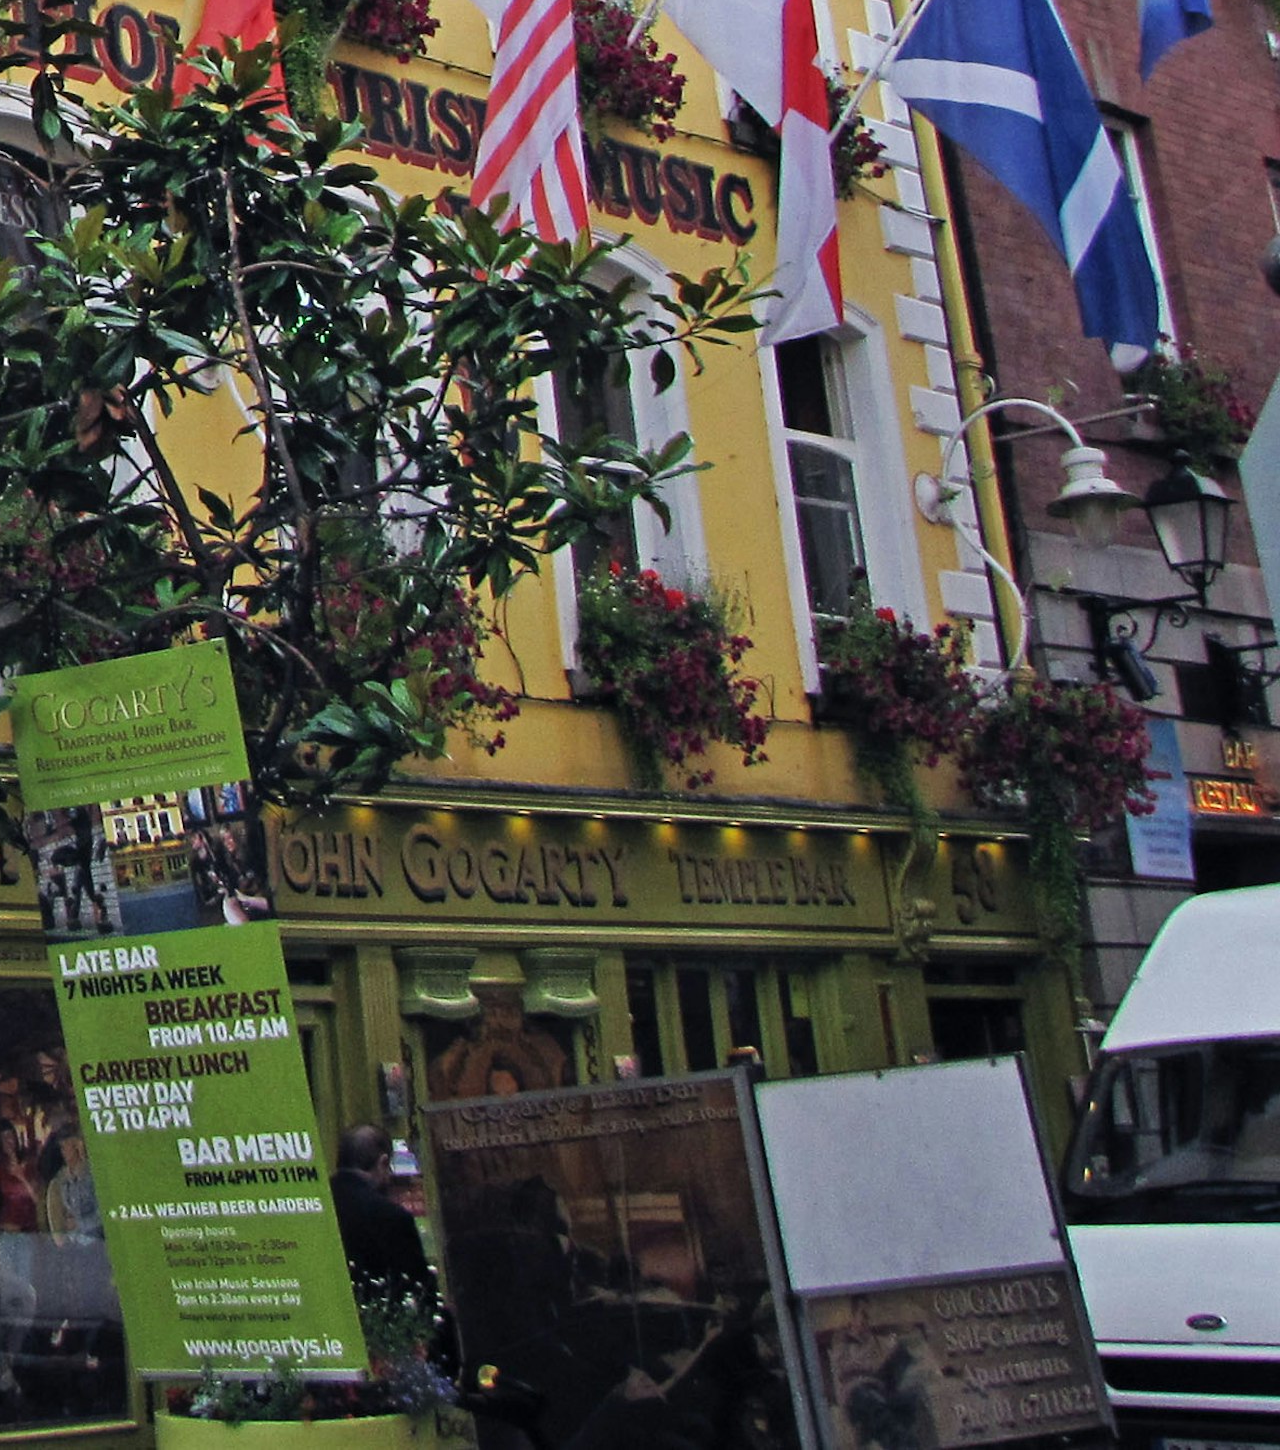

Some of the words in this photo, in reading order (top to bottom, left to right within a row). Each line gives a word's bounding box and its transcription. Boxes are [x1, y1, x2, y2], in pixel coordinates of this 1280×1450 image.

[327, 60, 487, 176] IRIS
[105, 746, 116, 762] &
[266, 818, 383, 900] JOHN
[400, 821, 630, 908] GOGARTY
[667, 847, 787, 907] TEMPLE
[788, 852, 856, 908] BAR
[59, 949, 114, 976] LATE
[114, 945, 159, 971] BAR
[63, 980, 75, 1000] 7
[81, 974, 147, 998] NIGHTS
[151, 972, 165, 991] A
[167, 965, 226, 988] WEEK
[144, 989, 281, 1025] BREAKFAST
[148, 1027, 203, 1048] FROM
[205, 1019, 257, 1044] 10.45
[259, 1016, 290, 1039] AM
[80, 1055, 174, 1084] CARVERY
[176, 1050, 251, 1077] LUNCH
[84, 1083, 150, 1111] EVERY
[153, 1080, 194, 1104] DAY
[90, 1111, 117, 1134] 12
[118, 1108, 144, 1131] TO
[146, 1104, 192, 1129] 4PM
[177, 1136, 234, 1166] BAR
[234, 1131, 314, 1163] MENU
[184, 1171, 226, 1188] FROM
[227, 1168, 258, 1185] 4PM
[259, 1167, 279, 1183] TO
[280, 1165, 319, 1183] 11PM
[130, 1204, 153, 1219] ALL
[155, 1200, 219, 1218] WEATHER
[221, 1199, 257, 1215] BEER
[259, 1196, 323, 1214] GARDENS
[183, 1332, 344, 1365] www.gogartys.ie
